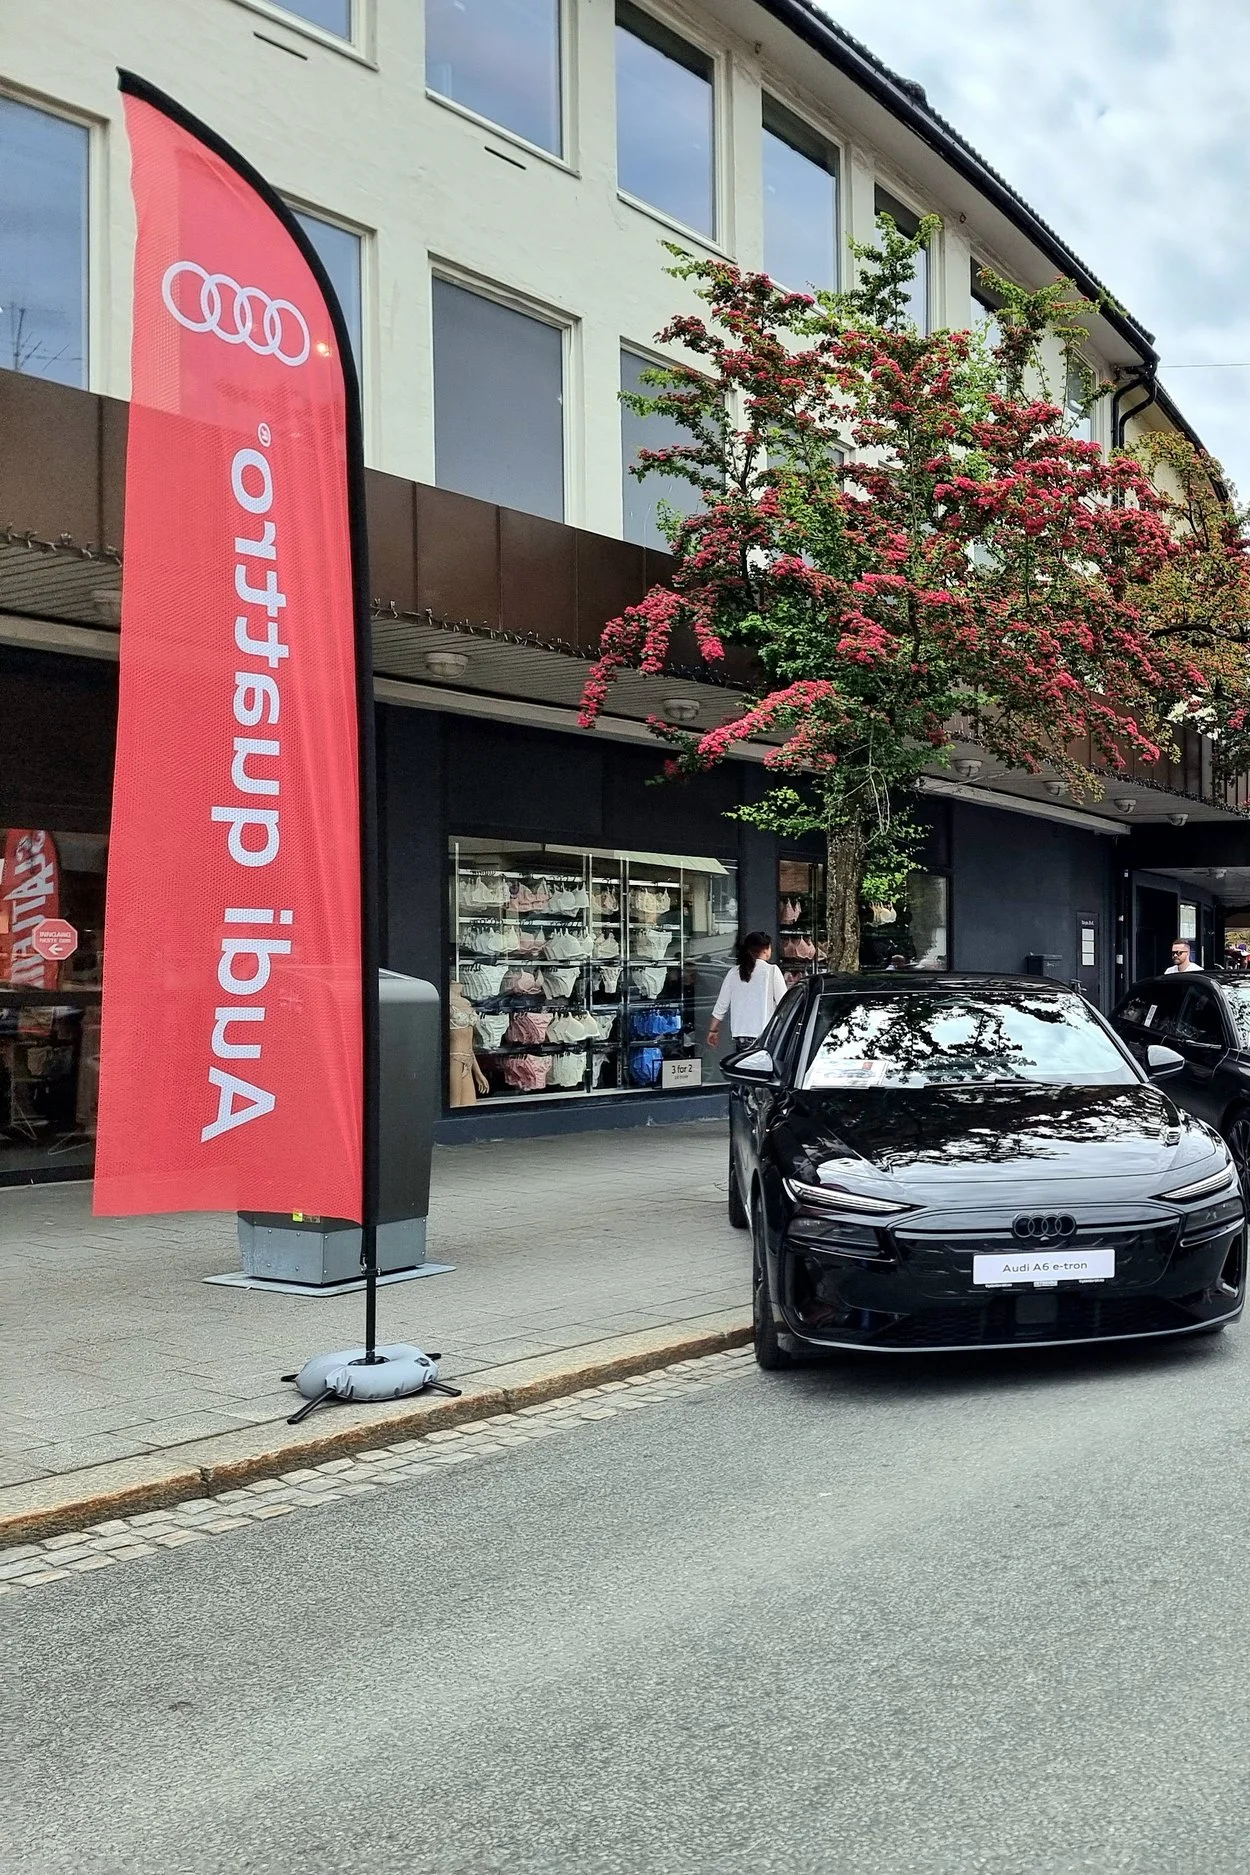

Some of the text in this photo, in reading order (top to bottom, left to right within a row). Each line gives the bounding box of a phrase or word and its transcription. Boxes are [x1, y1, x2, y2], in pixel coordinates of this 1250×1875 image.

[671, 1064, 693, 1074] 3 for 2
[1002, 1261, 1088, 1273] Audi A6 e-tron
